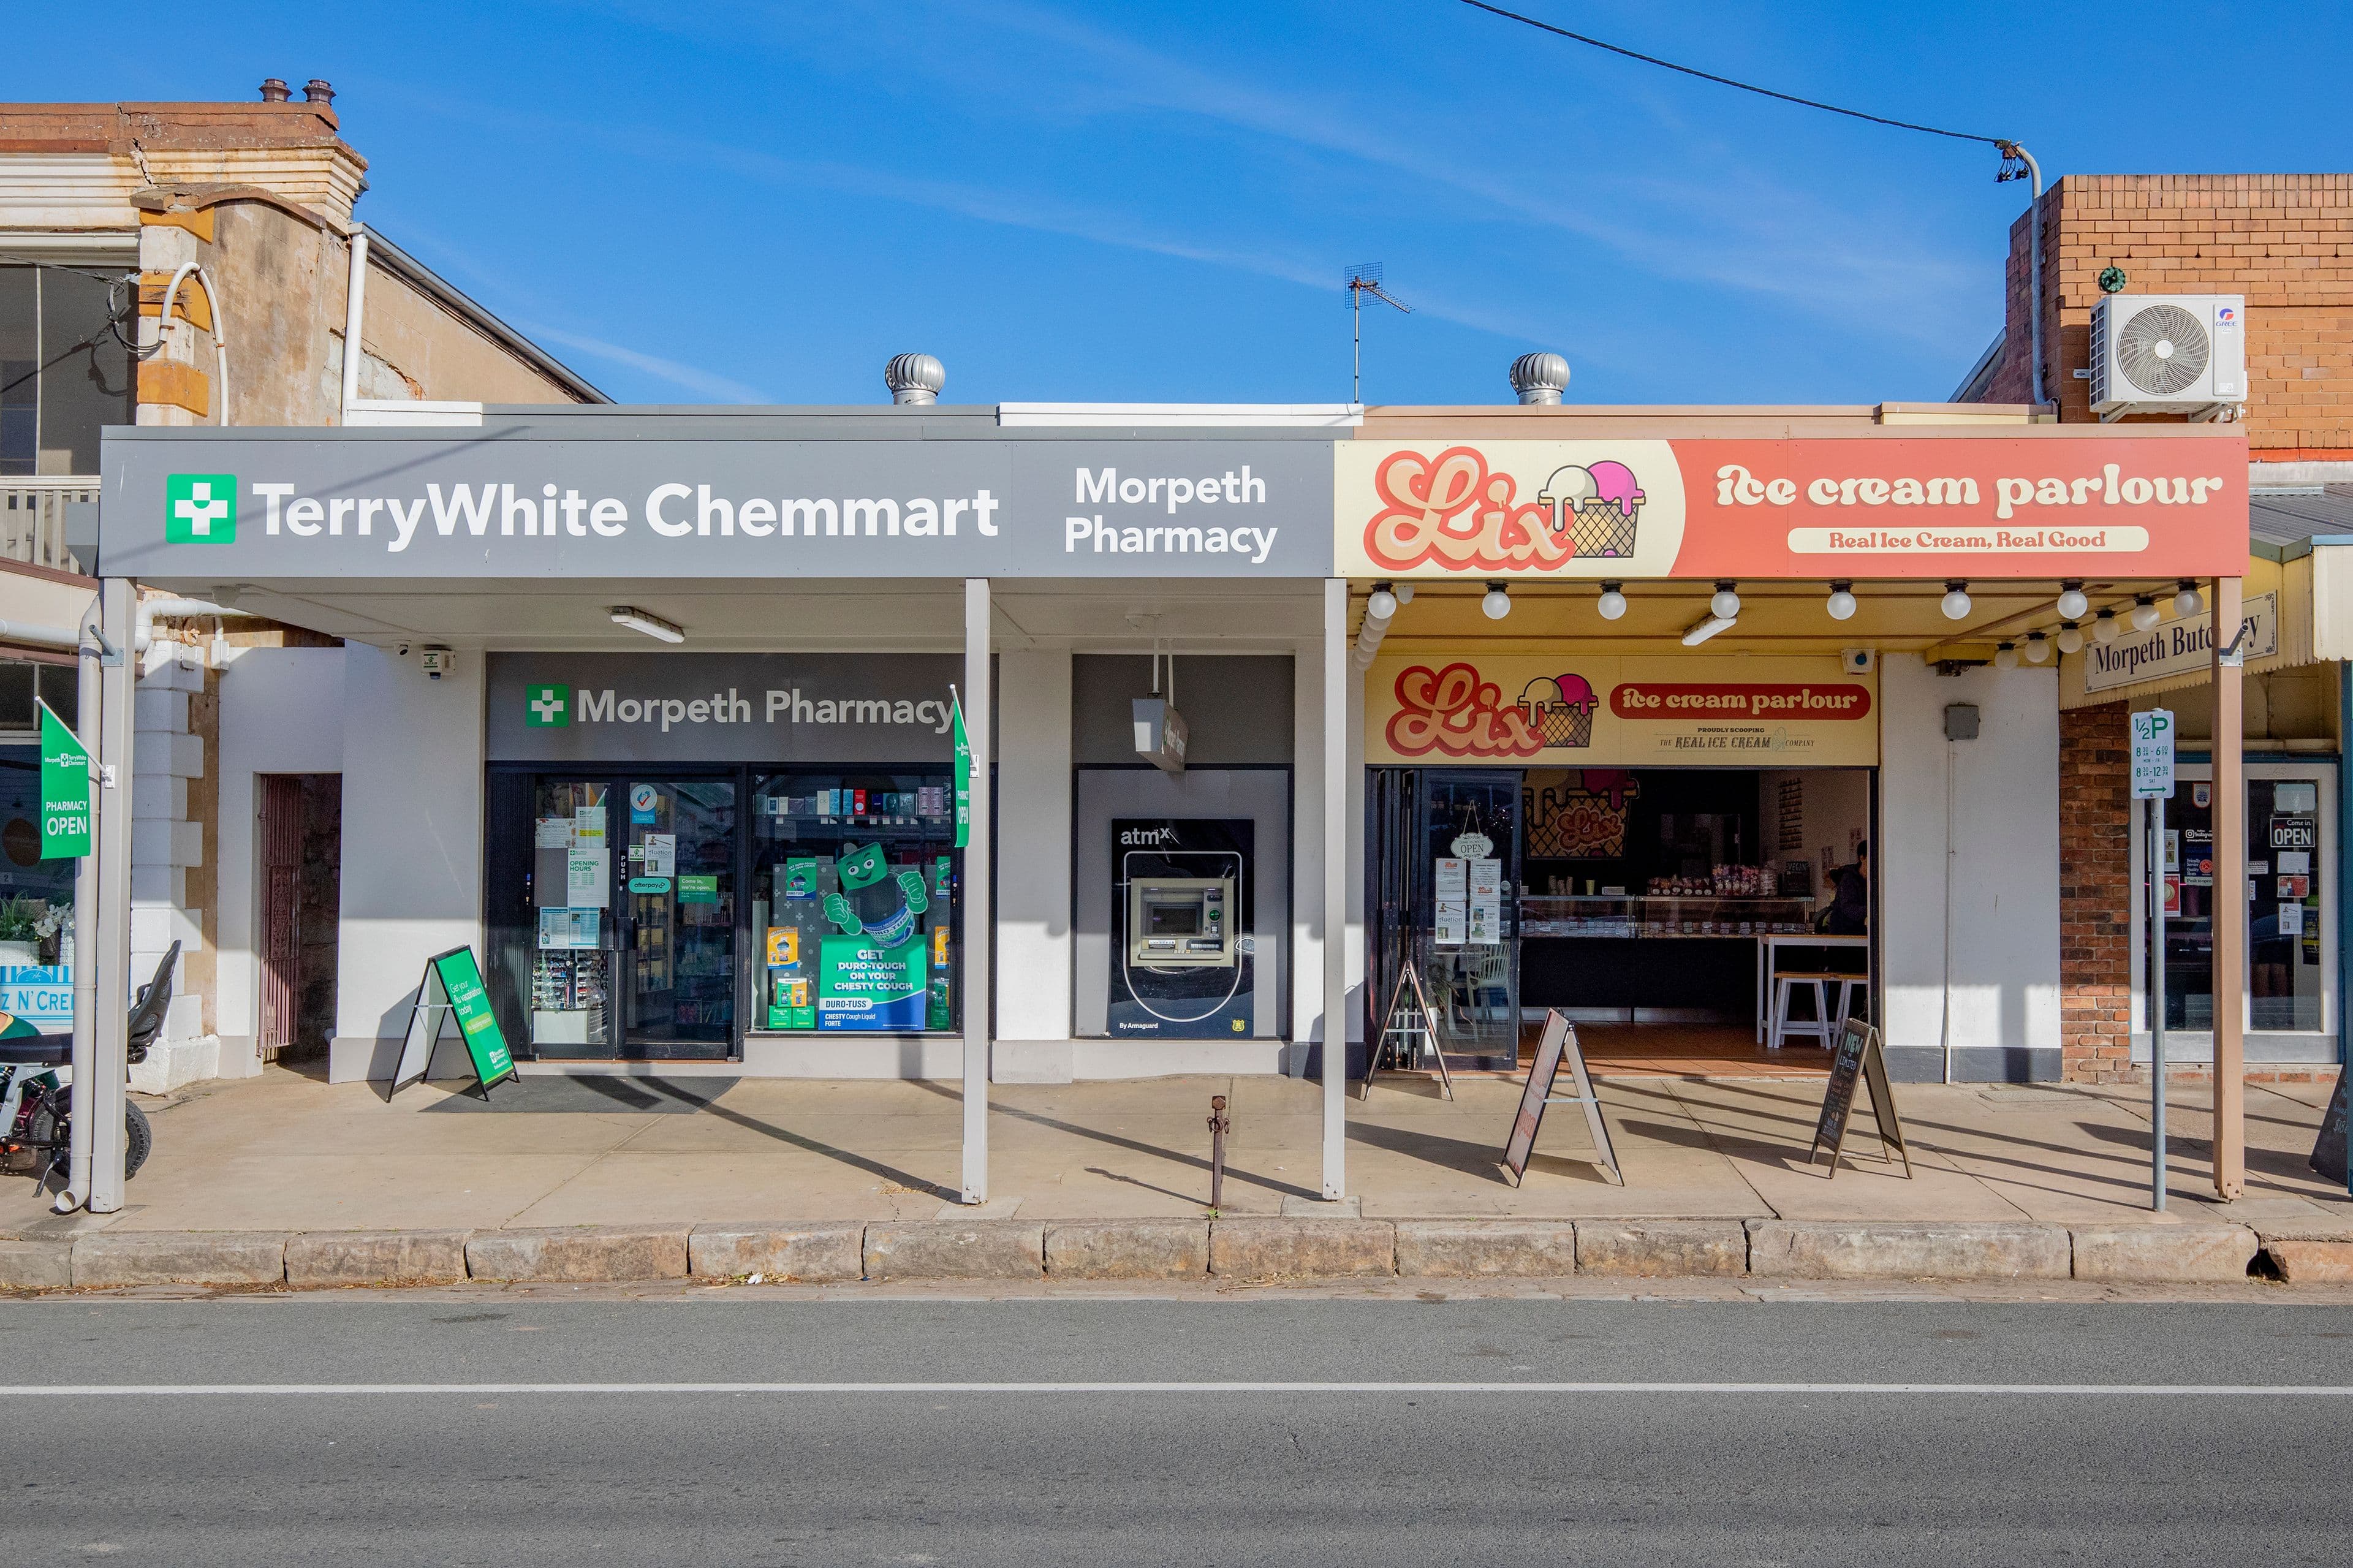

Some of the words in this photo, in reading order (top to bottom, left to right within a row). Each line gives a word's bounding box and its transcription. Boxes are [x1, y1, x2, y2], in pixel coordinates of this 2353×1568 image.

[1077, 466, 1265, 514] Morpeth
[1717, 464, 1796, 505] ice
[1808, 478, 1980, 505] cream
[1996, 464, 2223, 518] parlour
[253, 483, 627, 551] TerryWhite
[646, 483, 998, 537] Chemmart
[1363, 446, 1576, 572] Lix
[1066, 515, 1278, 564] Pharmacy
[1829, 532, 1876, 548] Real
[1881, 532, 1911, 548] Ice
[1916, 533, 1991, 548] Cream,
[1997, 532, 2044, 547] Real
[2048, 531, 2105, 547] Good
[2095, 632, 2165, 675] Morpeth
[2172, 615, 2260, 657] Butcy
[578, 689, 751, 732] Morpeth
[766, 683, 955, 734] Pharmacy
[1387, 662, 1545, 757] Lix
[1623, 689, 1661, 708] ice
[1666, 692, 1747, 708] cream
[1752, 689, 1857, 714] parlour
[1675, 737, 1706, 749] REAL
[1708, 737, 1728, 749] ICE
[1731, 737, 1771, 749] CREAM
[46, 801, 87, 811] PHARMACY
[958, 806, 969, 824] OPEN
[47, 816, 86, 836] OPEN
[2274, 828, 2311, 845] OPEN
[1460, 844, 1484, 854] OPEN
[1788, 862, 1808, 871] VEGAN
[857, 949, 885, 960] GET
[450, 983, 459, 993] Get
[459, 980, 469, 992] your
[461, 987, 483, 1002] vaccination
[458, 1004, 472, 1015] today
[1844, 1032, 1863, 1054] NEW
